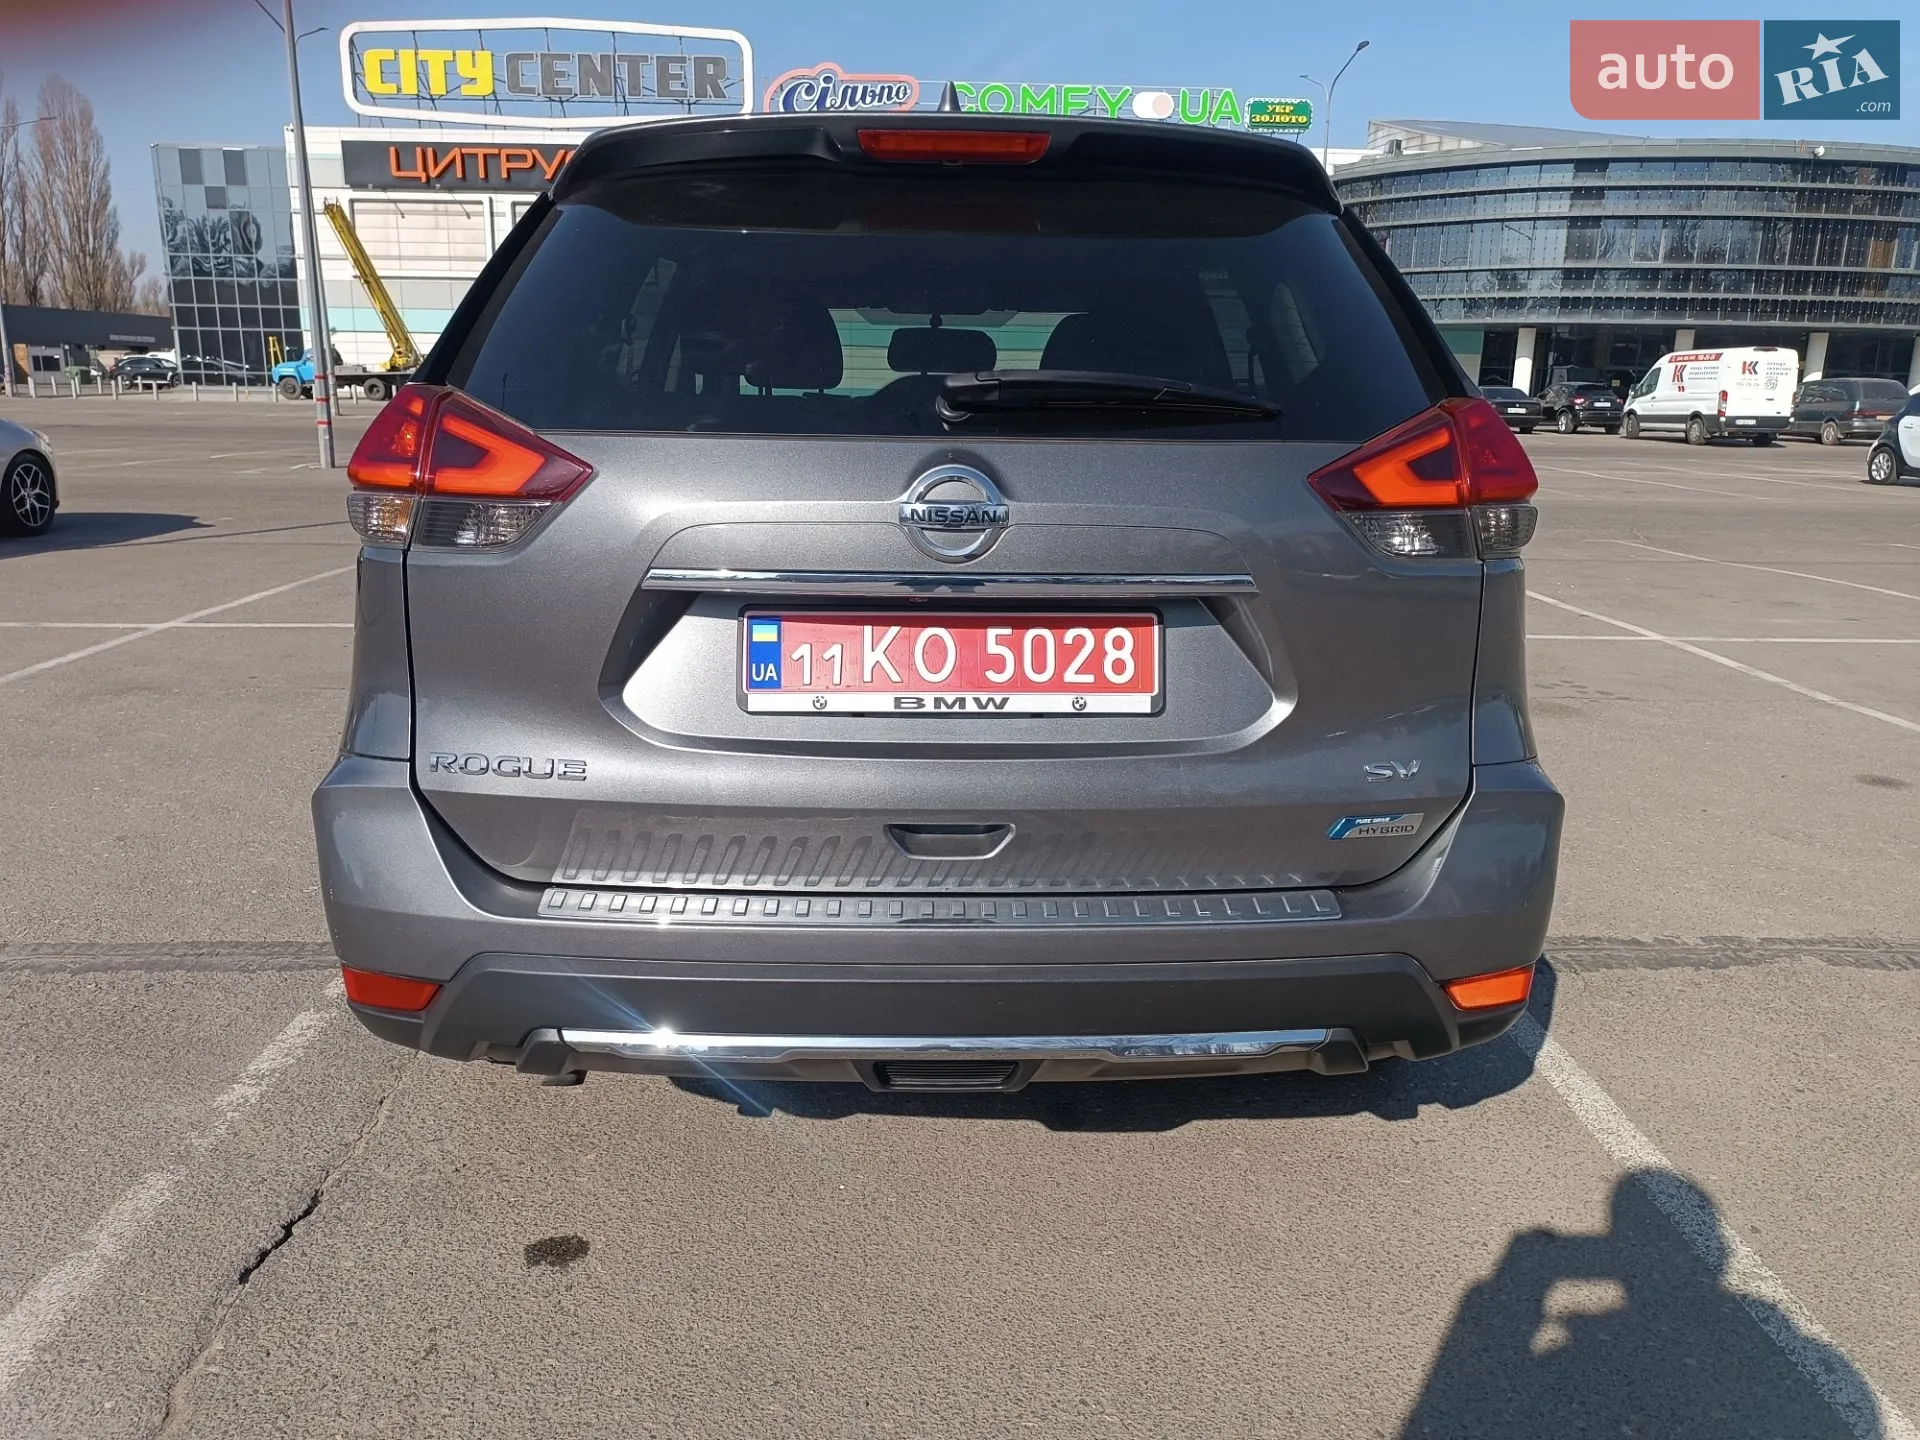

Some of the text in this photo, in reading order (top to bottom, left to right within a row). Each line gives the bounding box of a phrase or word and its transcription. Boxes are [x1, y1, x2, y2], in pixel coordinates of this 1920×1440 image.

[363, 48, 729, 99] CITY CENTER
[779, 74, 911, 111] Сільпо
[1179, 88, 1242, 125] UA
[1251, 114, 1308, 124] ЗОЛОТО
[1266, 104, 1295, 113] УКР
[389, 146, 575, 184] ЦИТРУ
[910, 508, 997, 524] NISSAN
[752, 625, 1135, 686] UA 11 KO 5028
[893, 696, 1011, 711] BMW
[430, 752, 588, 781] ROGUE
[1363, 759, 1422, 783] SV
[1358, 825, 1415, 836] HYBRID
